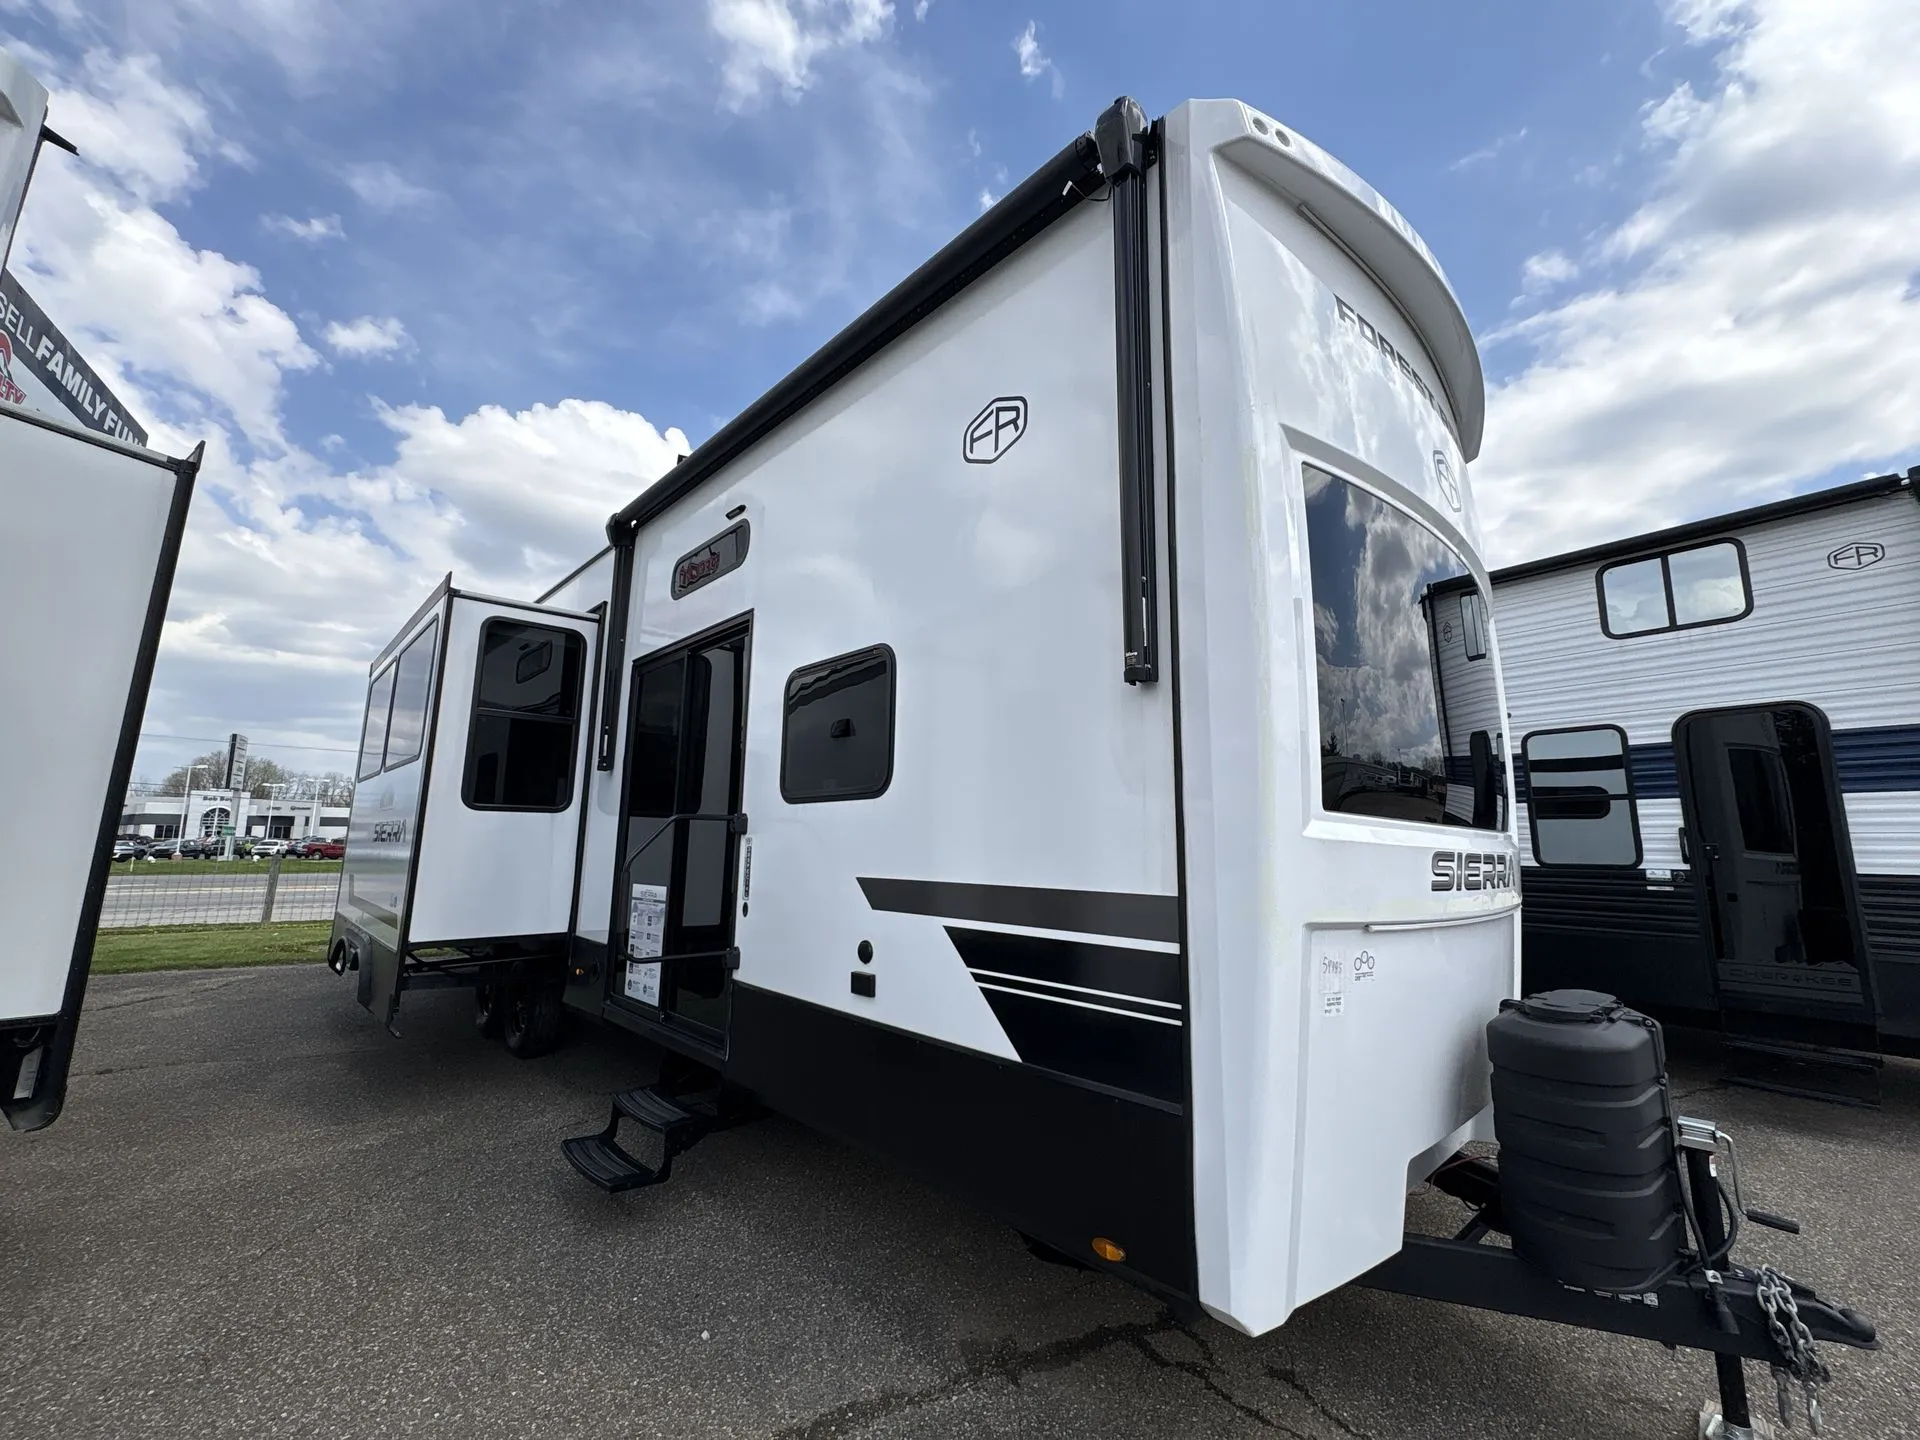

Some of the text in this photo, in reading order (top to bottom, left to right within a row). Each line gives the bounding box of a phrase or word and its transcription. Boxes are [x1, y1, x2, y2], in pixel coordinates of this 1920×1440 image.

[1333, 292, 1437, 411] FOREST
[36, 334, 107, 421] FAMILY
[968, 404, 1022, 456] FR
[1832, 545, 1880, 567] FR
[373, 819, 407, 842] SIERRA
[1431, 850, 1516, 892] SIERRA
